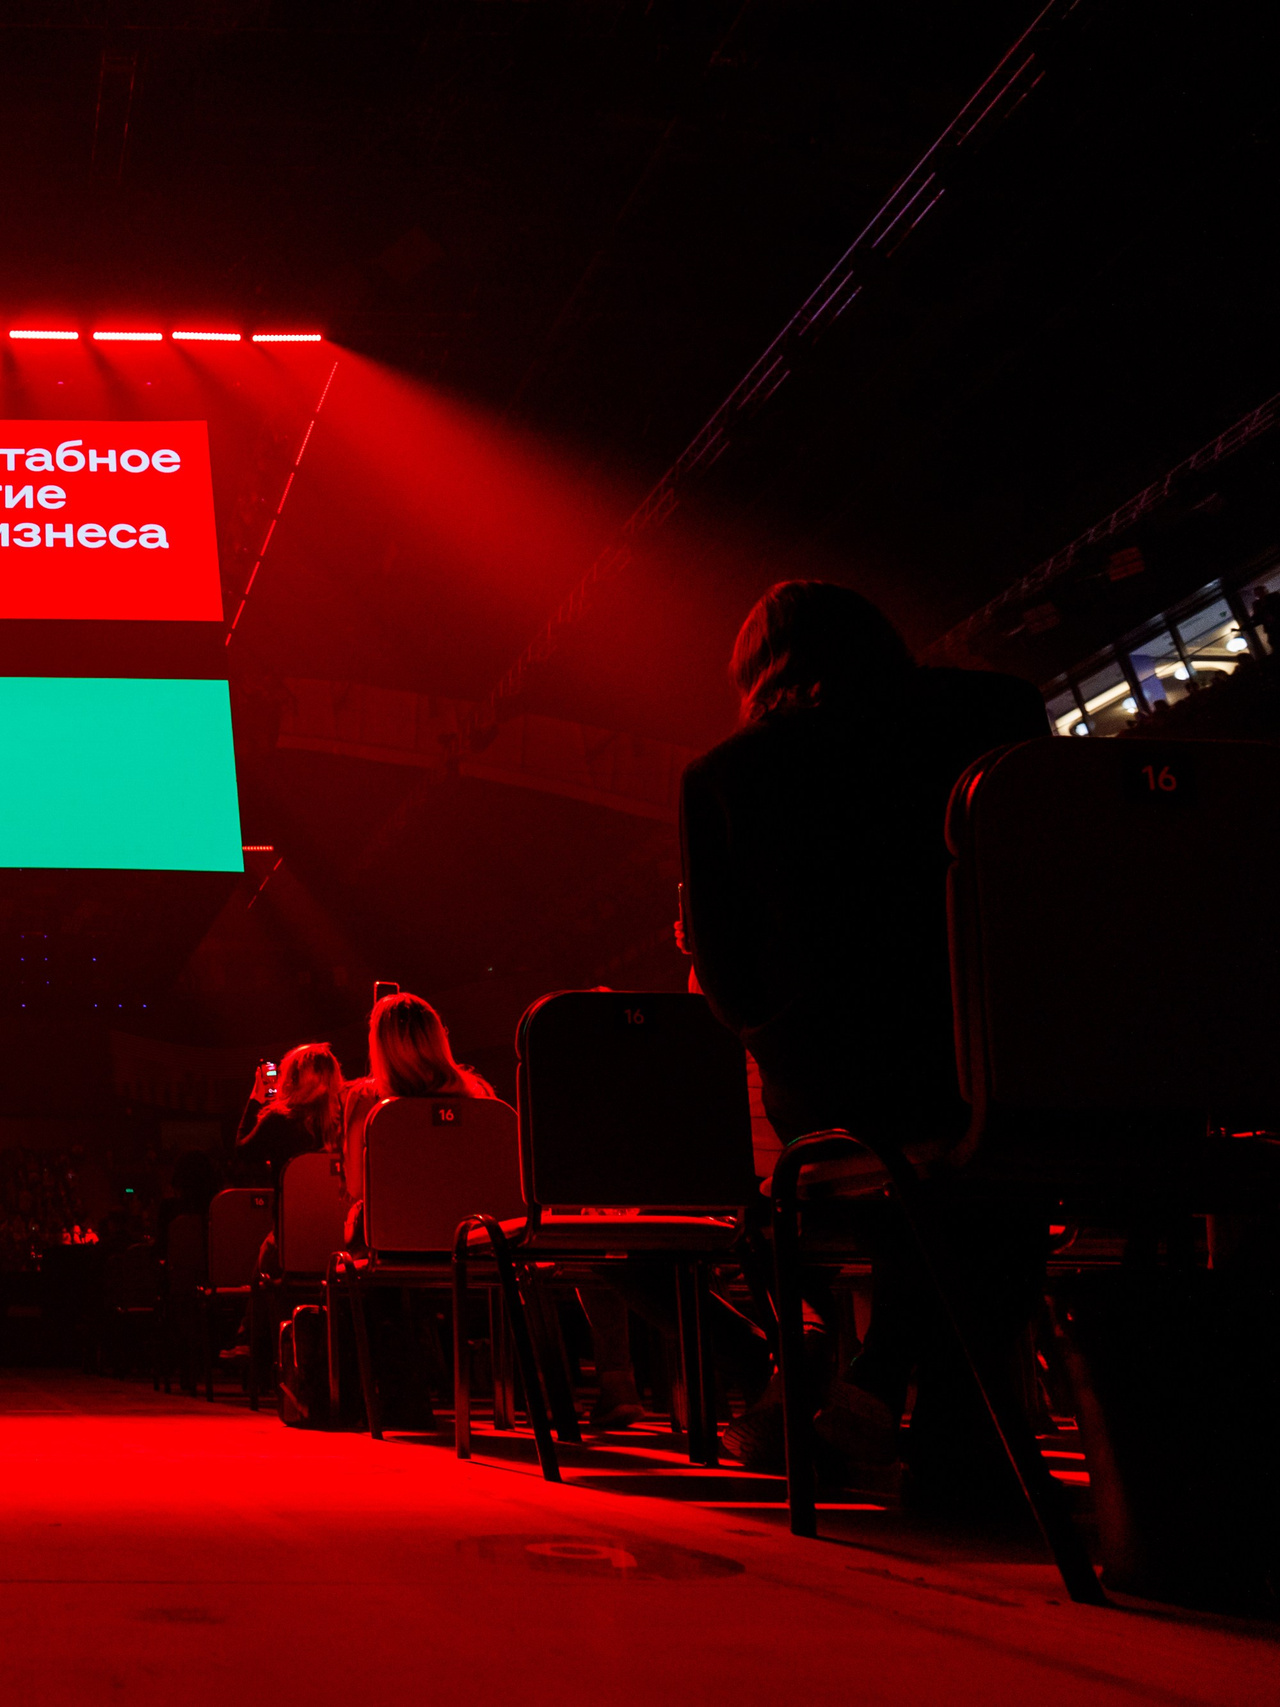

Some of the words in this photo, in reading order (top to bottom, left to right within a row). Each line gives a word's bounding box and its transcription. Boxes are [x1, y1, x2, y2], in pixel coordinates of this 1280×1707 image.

[1141, 764, 1178, 792] 16
[623, 1008, 645, 1024] 16
[438, 1109, 454, 1121] 16
